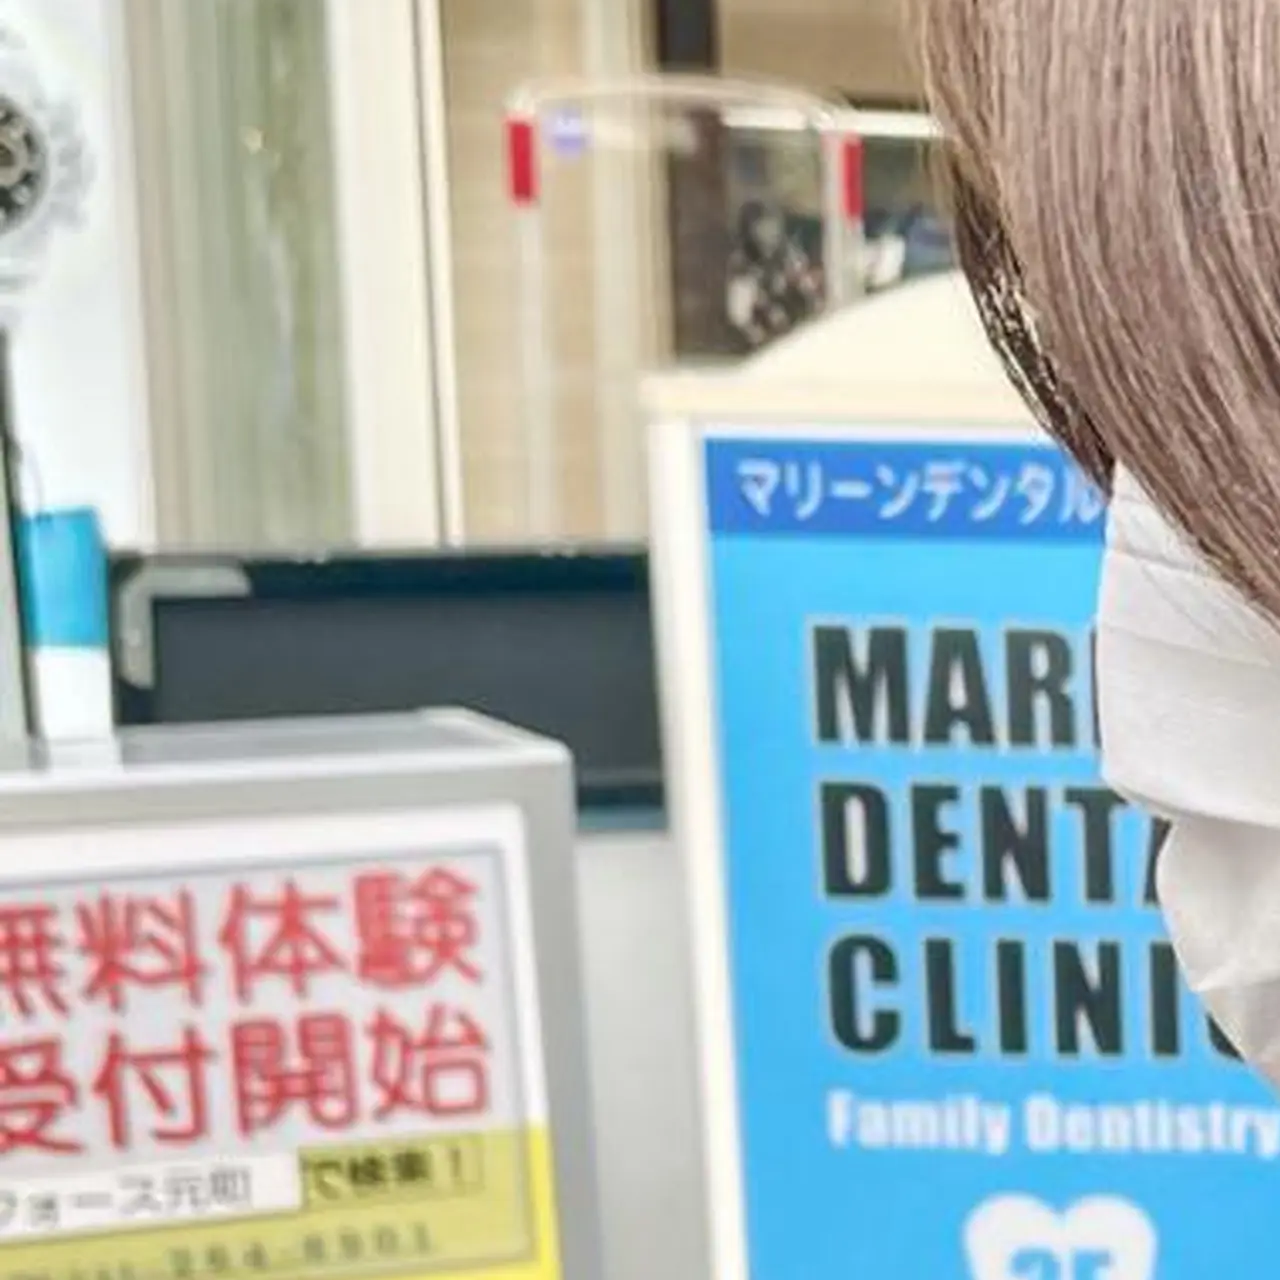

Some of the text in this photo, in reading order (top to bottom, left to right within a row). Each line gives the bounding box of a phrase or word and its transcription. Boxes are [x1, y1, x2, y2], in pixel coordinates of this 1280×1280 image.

[812, 625, 1099, 748] MAR
[818, 782, 1172, 902] DENT
[0, 1001, 491, 1155] 受付開始
[828, 1089, 1010, 1155] Family
